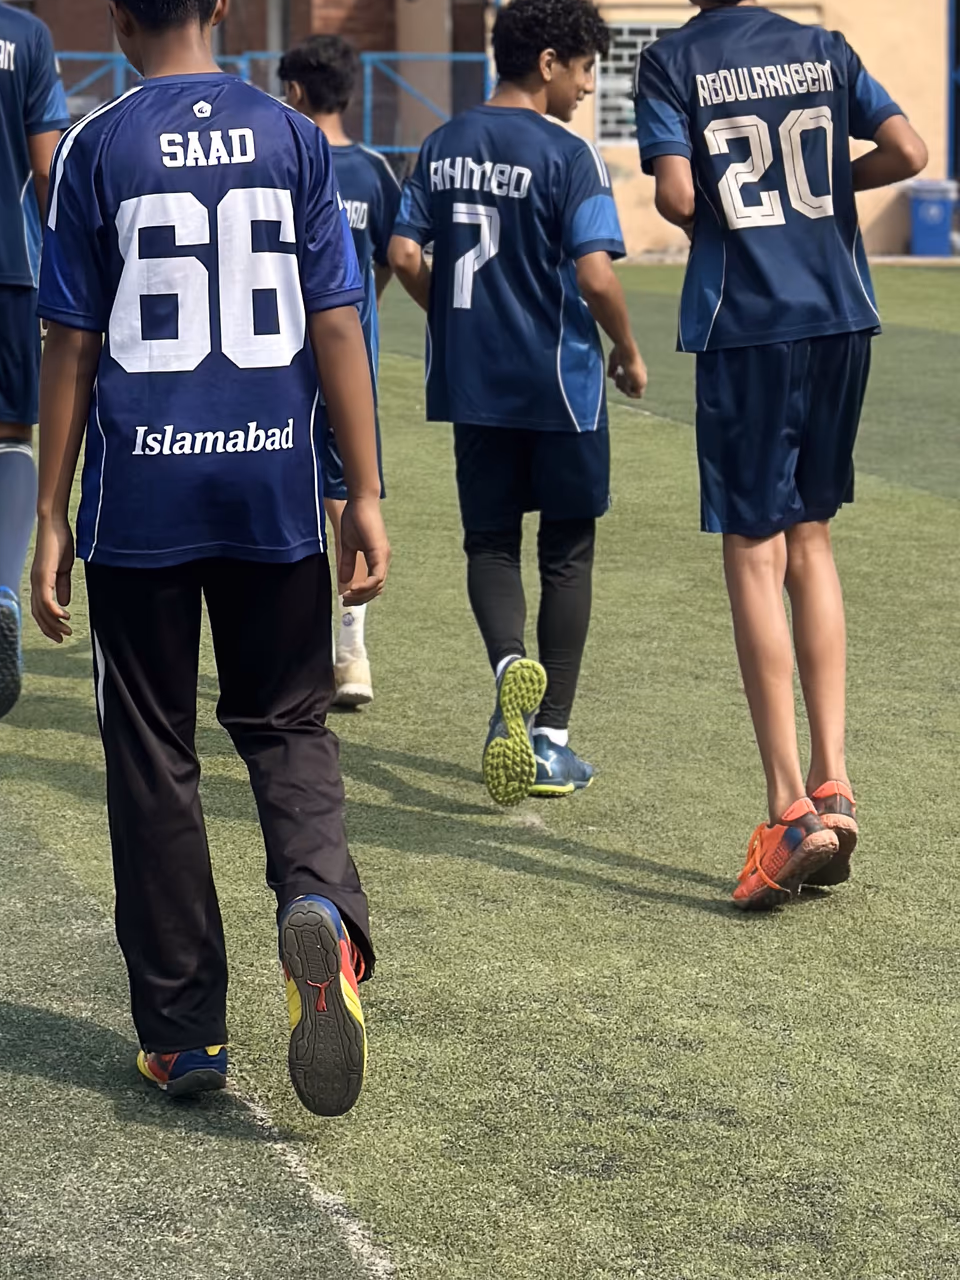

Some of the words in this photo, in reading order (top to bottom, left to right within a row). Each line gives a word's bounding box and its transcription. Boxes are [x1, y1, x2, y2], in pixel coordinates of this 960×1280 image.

[159, 127, 256, 168] SAAD
[430, 156, 533, 199] AHMED
[703, 105, 834, 230] 20
[108, 187, 306, 373] 66
[452, 202, 501, 310] 7
[132, 418, 294, 455] Islamabad
